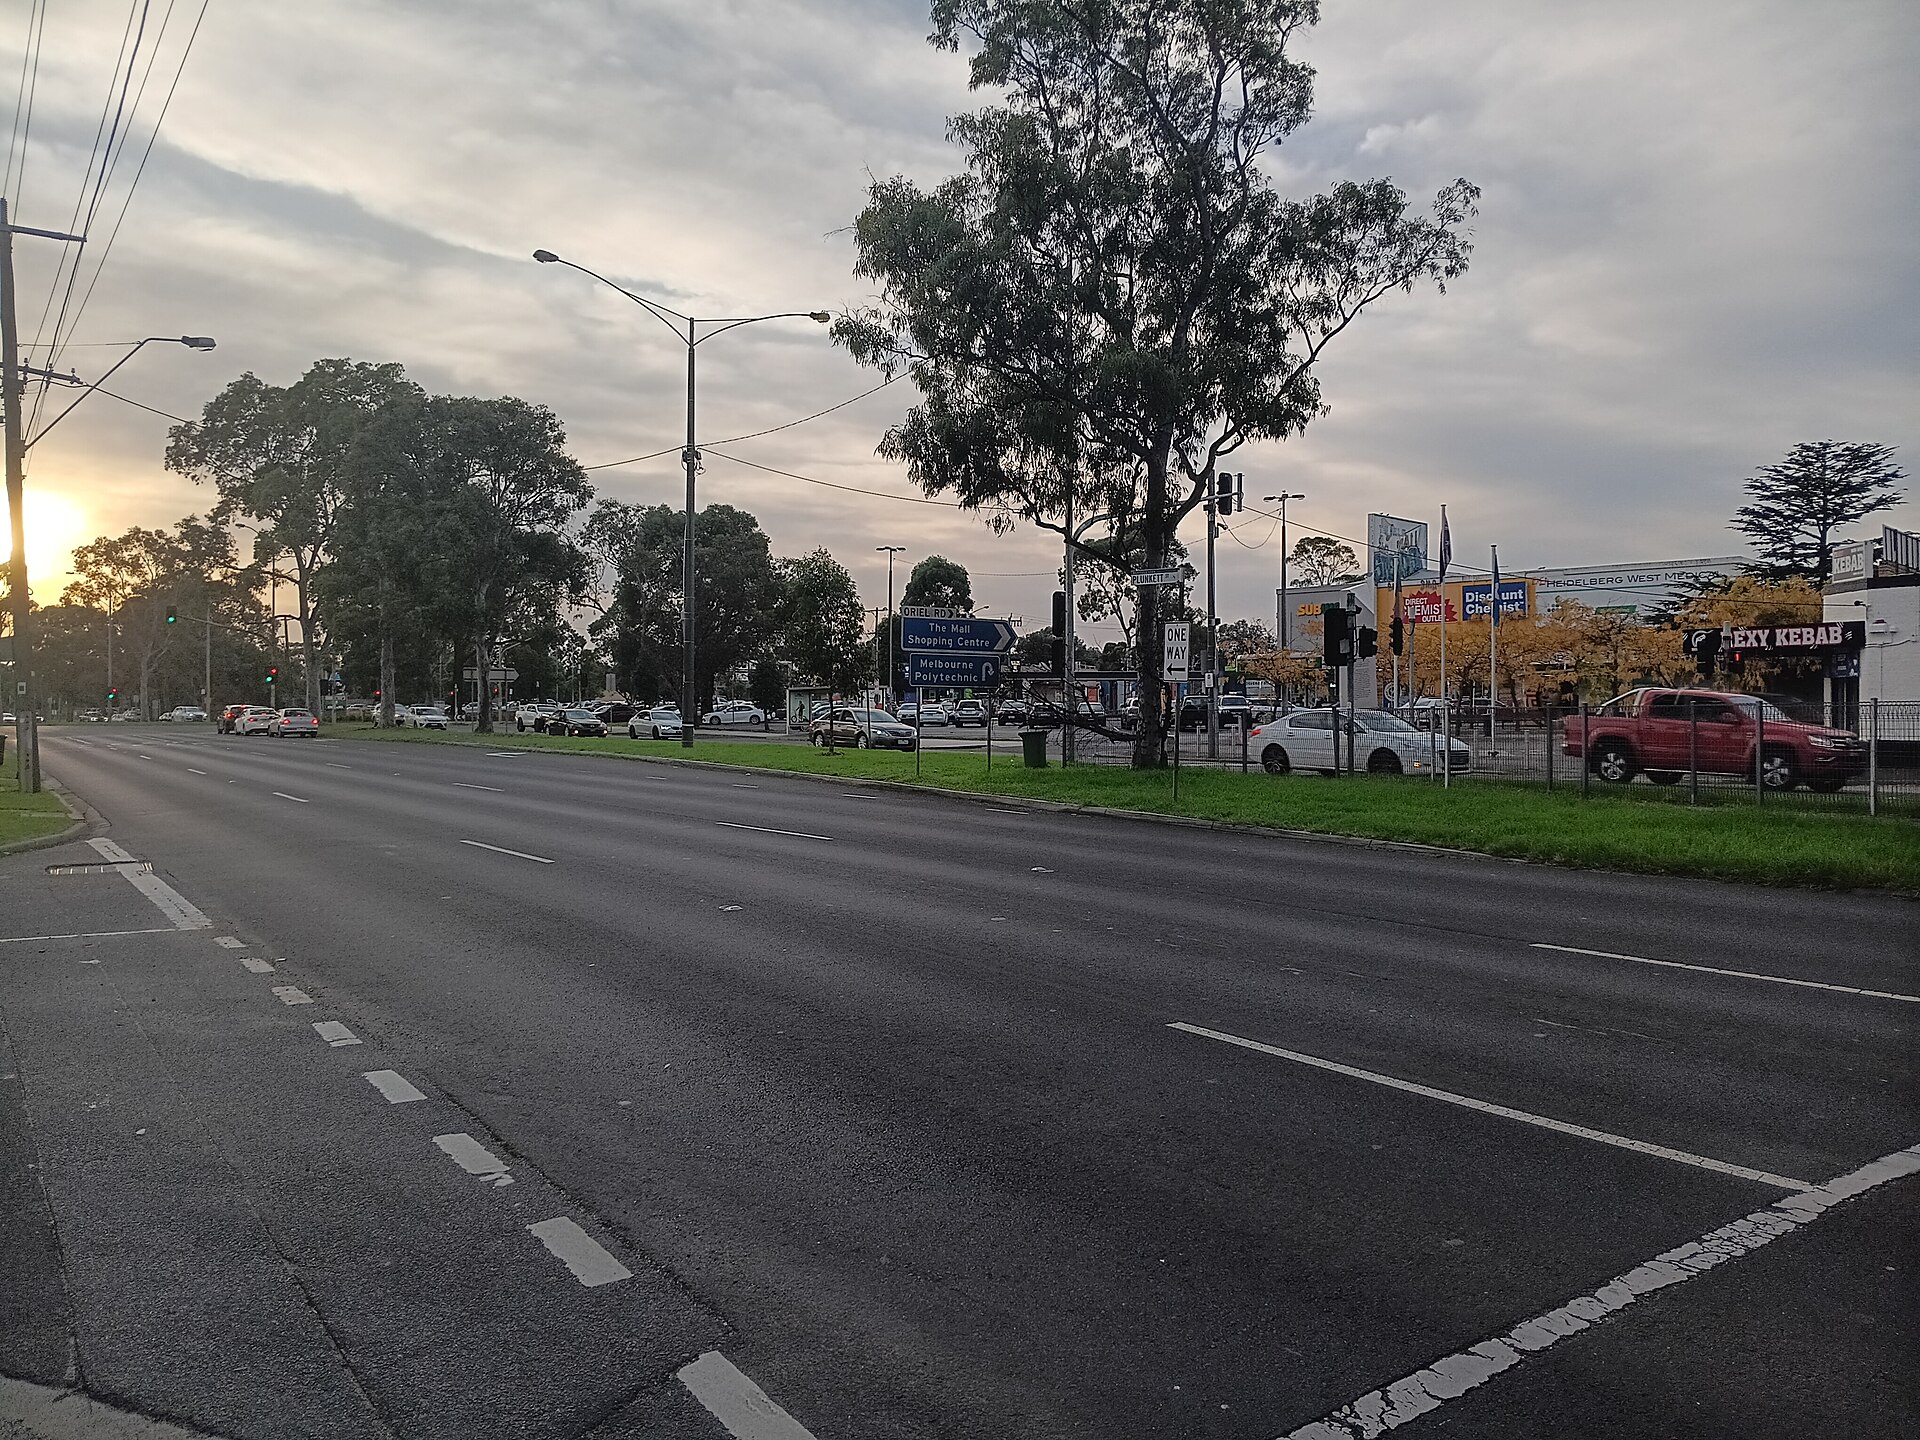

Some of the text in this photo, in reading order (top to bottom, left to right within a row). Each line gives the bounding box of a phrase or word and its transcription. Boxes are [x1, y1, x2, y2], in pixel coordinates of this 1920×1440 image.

[1833, 553, 1863, 574] KEBAB
[1132, 574, 1163, 584] PLUNKETT
[1547, 577, 1623, 587] HEIDELBERG
[1627, 574, 1661, 583] WEST
[1405, 597, 1428, 606] DIRECT
[1465, 589, 1524, 603] Discunt
[904, 607, 946, 617] ORIEL RD
[929, 623, 970, 633] The Mall
[1167, 628, 1187, 641] ONE
[1721, 627, 1843, 648] EXY KEBAB
[908, 635, 990, 647] Shopping Centre
[1166, 646, 1187, 660] WAY
[920, 659, 974, 669] Melbourne
[915, 672, 978, 683] Polytechnic
